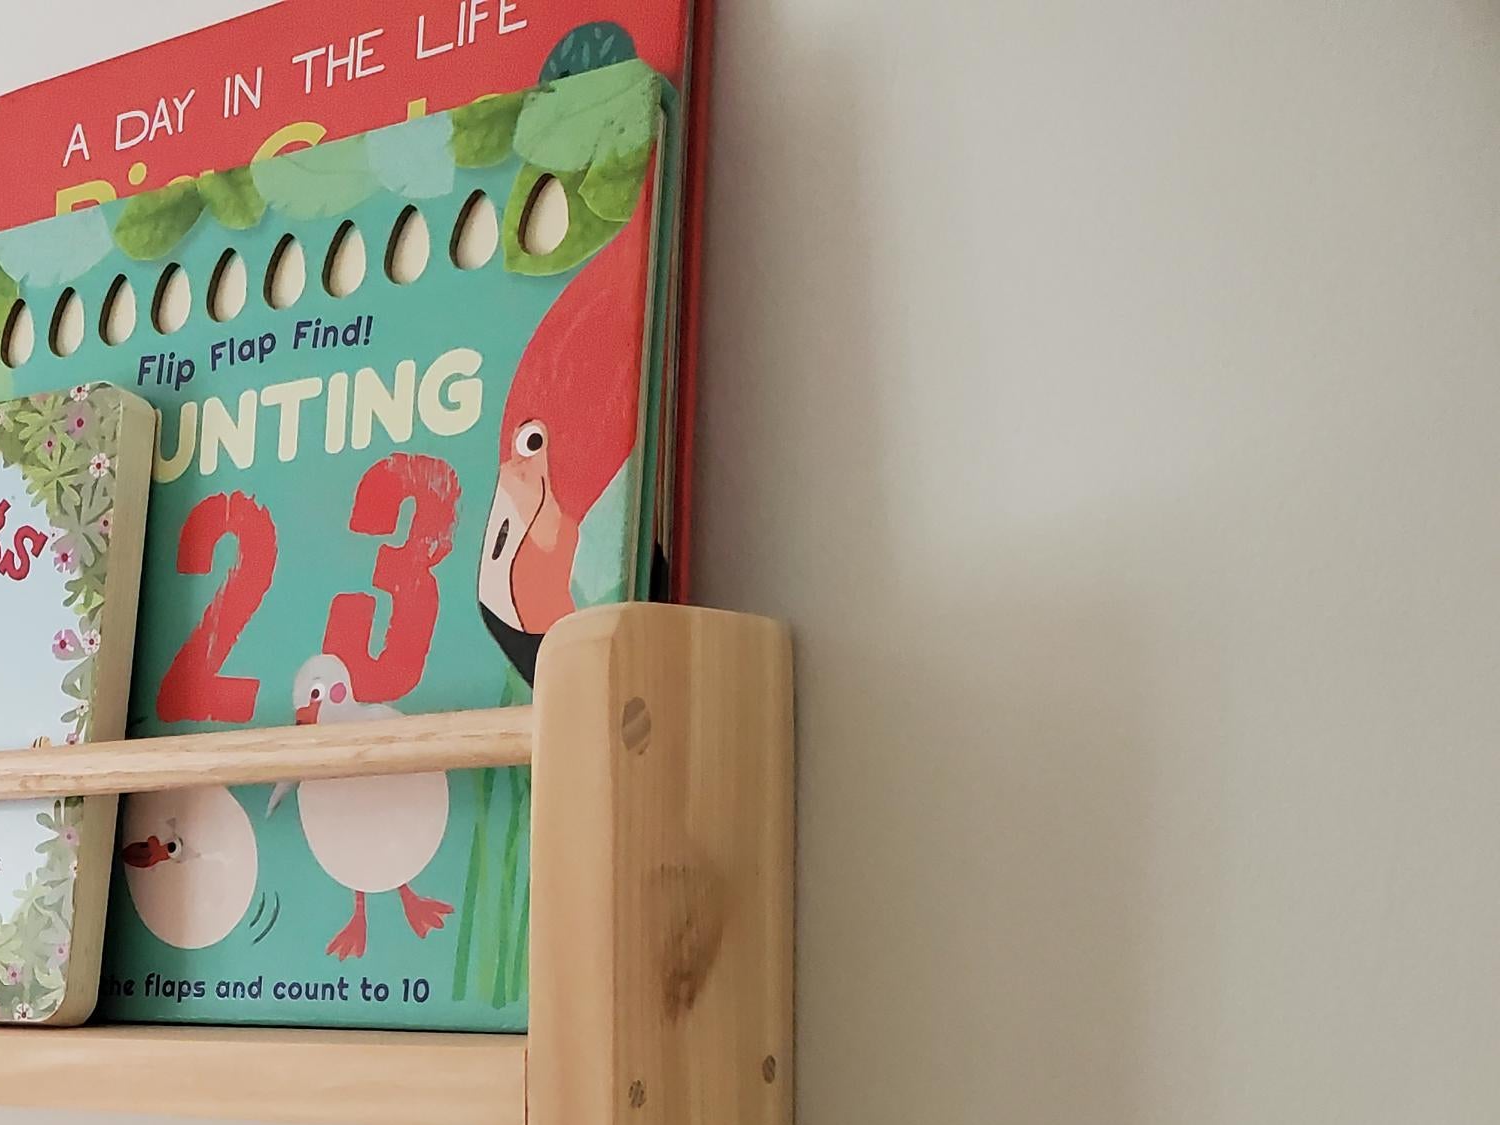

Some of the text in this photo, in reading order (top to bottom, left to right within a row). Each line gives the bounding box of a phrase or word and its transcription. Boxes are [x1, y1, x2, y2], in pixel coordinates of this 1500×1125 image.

[62, 122, 91, 168] A
[114, 88, 196, 151] DAY
[223, 66, 262, 119] IN
[291, 28, 385, 95] THE
[416, 0, 528, 60] LIFE
[136, 315, 374, 392] Flip Flap Find!
[153, 346, 484, 484] UNTING
[156, 451, 463, 724] 2 3
[143, 972, 206, 1003] flaps
[215, 975, 263, 1001] and
[272, 976, 350, 1002] count
[360, 976, 390, 1002] to
[401, 977, 431, 1003] 10
